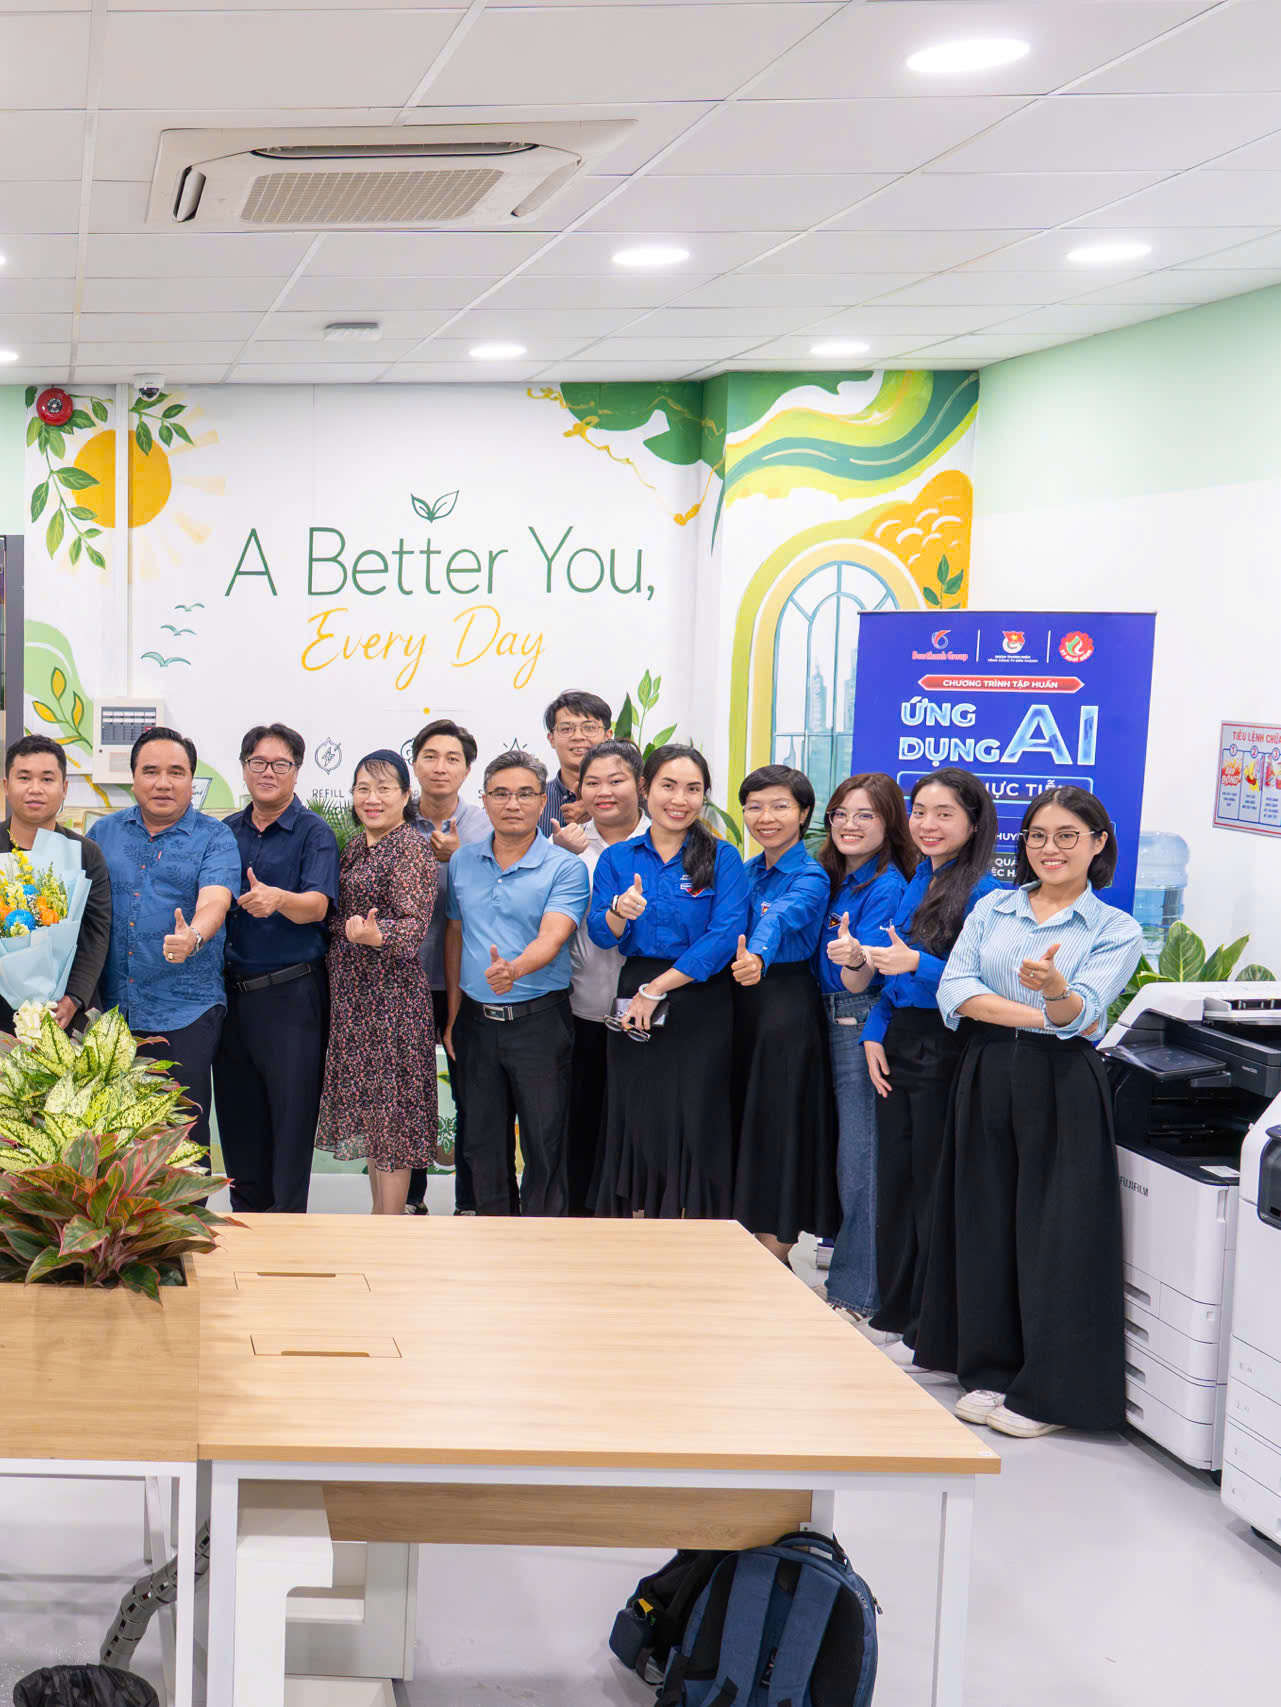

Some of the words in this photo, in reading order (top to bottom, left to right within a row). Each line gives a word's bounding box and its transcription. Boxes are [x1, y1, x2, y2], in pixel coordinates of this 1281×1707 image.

[225, 528, 278, 597] A
[307, 526, 508, 596] Better
[528, 526, 655, 600] You,
[301, 607, 428, 690] Every
[450, 605, 546, 689] Day
[943, 678, 982, 688] CHƯƠNG
[984, 679, 1012, 688] TRÌNH
[1013, 679, 1030, 689] TẬP
[1032, 679, 1058, 689] HUẤN
[901, 696, 976, 727] ỨNG
[1000, 704, 1099, 766] AI
[898, 736, 1000, 767] DỤNG
[312, 788, 345, 799] REFILL
[985, 780, 1019, 799] ỰC
[1026, 779, 1064, 797] TIỄ
[1119, 1176, 1149, 1198] FUJIFILM
